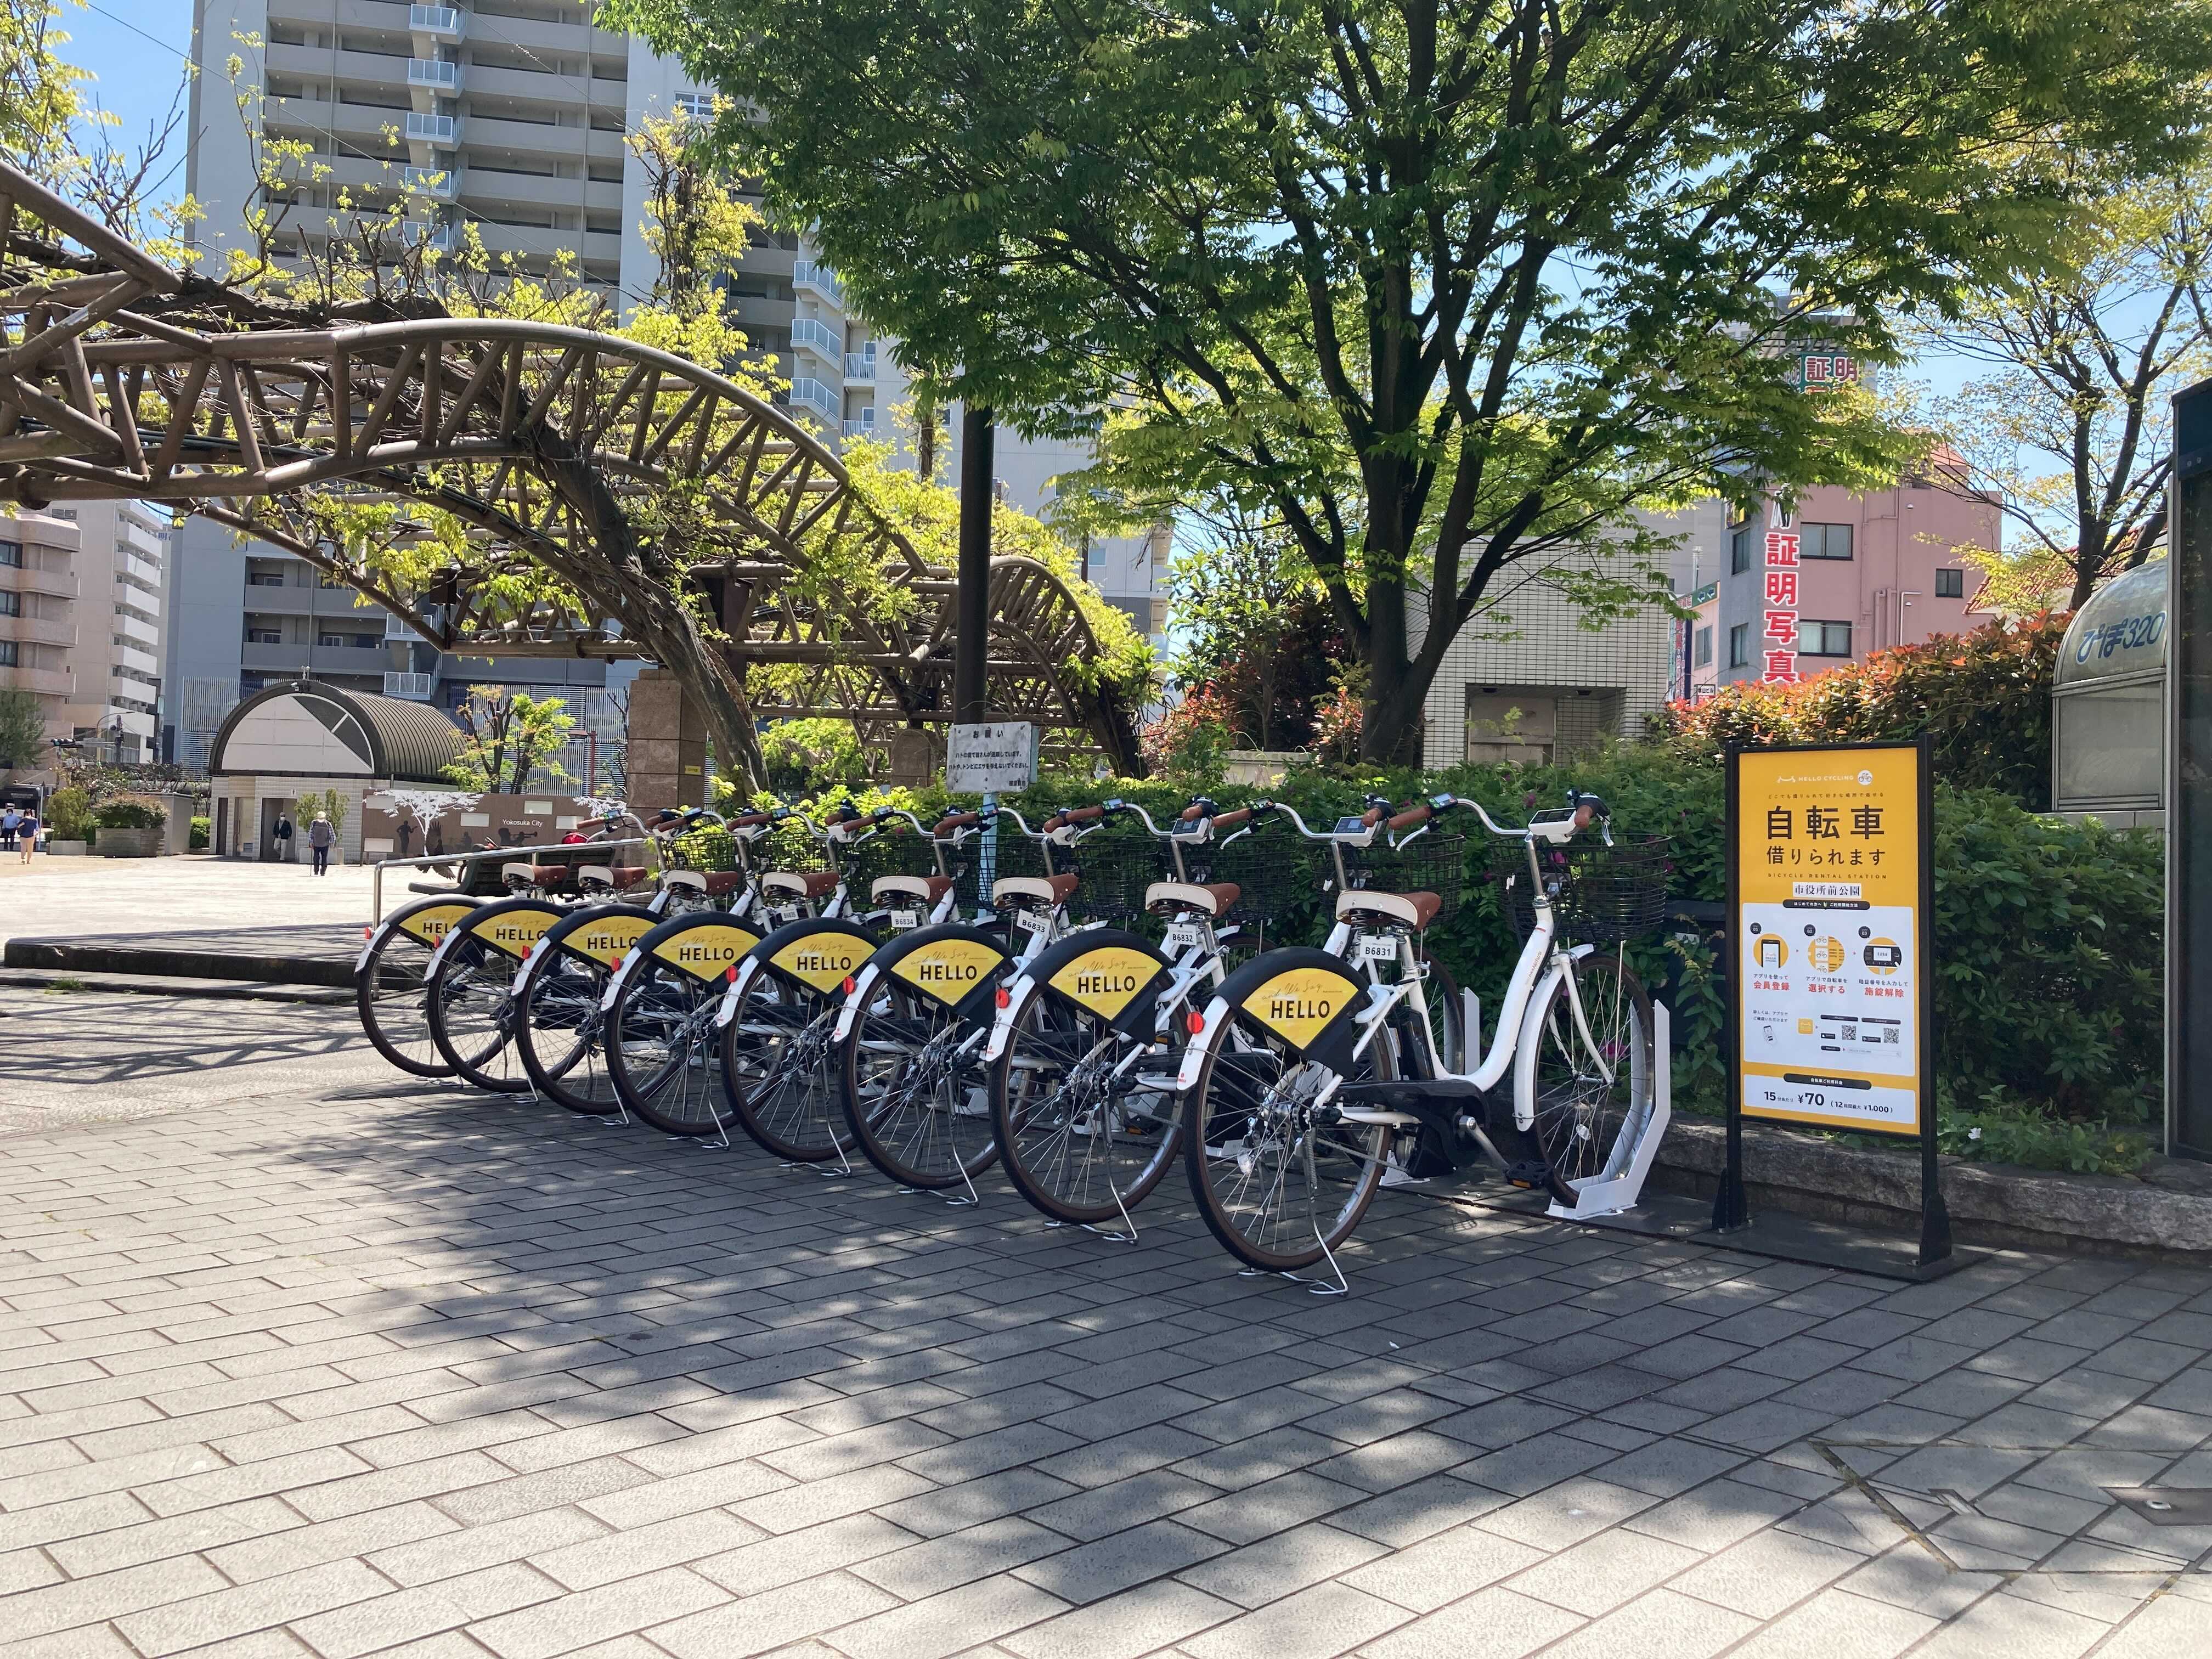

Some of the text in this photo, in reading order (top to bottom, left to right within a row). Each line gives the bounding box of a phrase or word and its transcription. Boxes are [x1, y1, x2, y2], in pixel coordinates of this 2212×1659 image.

[1805, 356, 1858, 383] 証明
[1764, 533, 1800, 684] 証明写真
[2076, 611, 2166, 664] ぴぽ320
[1767, 804, 1884, 839] 自転車
[1767, 845, 1885, 866] 借りられます
[1795, 884, 1860, 896] 市役所前公園
[1022, 919, 1045, 933] B6833
[496, 928, 546, 940] HELLO
[1172, 934, 1193, 942] B6832
[588, 936, 640, 950] HELLO
[680, 947, 734, 961] HELLO
[1365, 947, 1390, 956] B6831
[797, 956, 851, 970] HELLO
[920, 965, 977, 980] HELLO
[1078, 975, 1136, 993] HELLO
[1753, 980, 1790, 991] 会員登録
[1808, 983, 1845, 994] 選択する
[1865, 987, 1904, 998] 施錠解除
[1271, 1000, 1330, 1019] HELLO
[1798, 1092, 1825, 1106] ¥70
